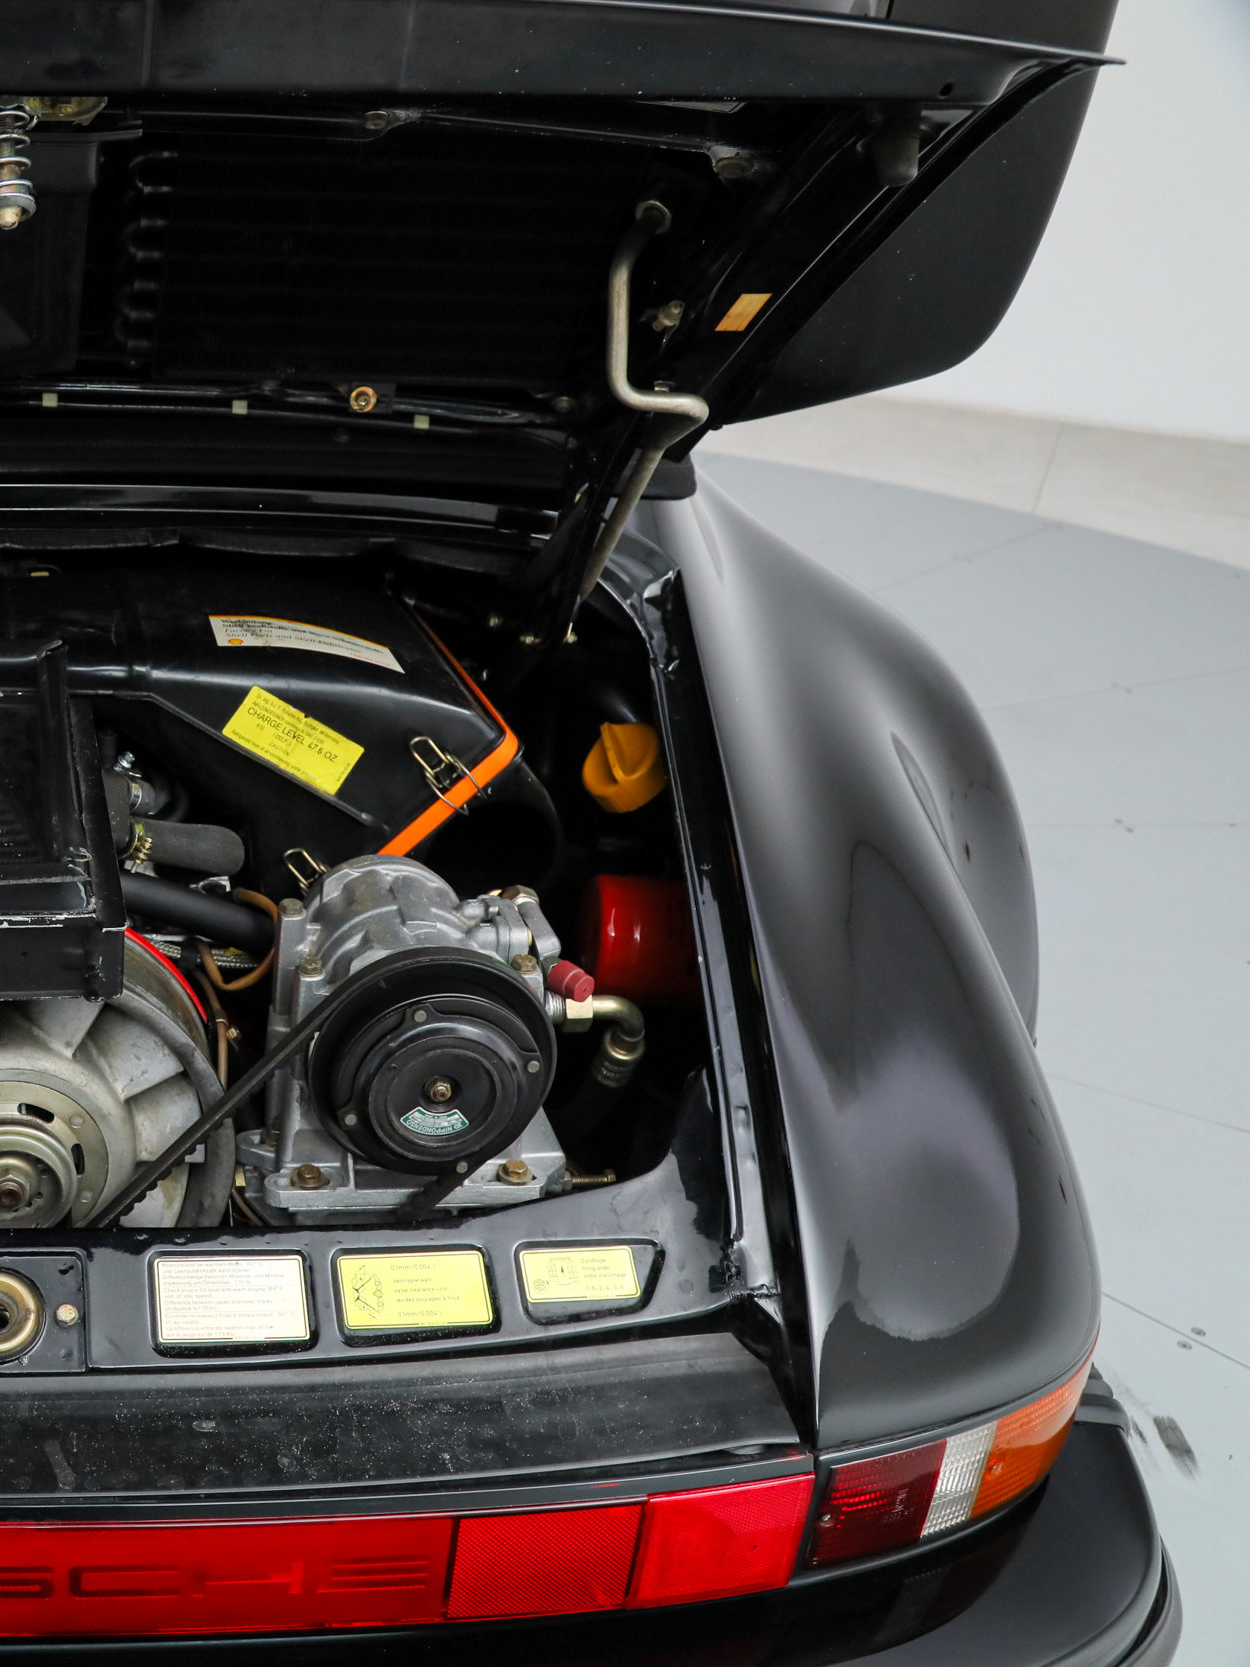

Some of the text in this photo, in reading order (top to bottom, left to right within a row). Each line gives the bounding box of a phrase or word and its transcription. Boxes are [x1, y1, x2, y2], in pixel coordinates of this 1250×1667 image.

[246, 706, 283, 731] CHARGE
[281, 726, 306, 744] LEVEL
[307, 741, 324, 755] 47.6
[323, 750, 338, 763] OZ
[406, 1119, 452, 1133] NIPPONDENSO
